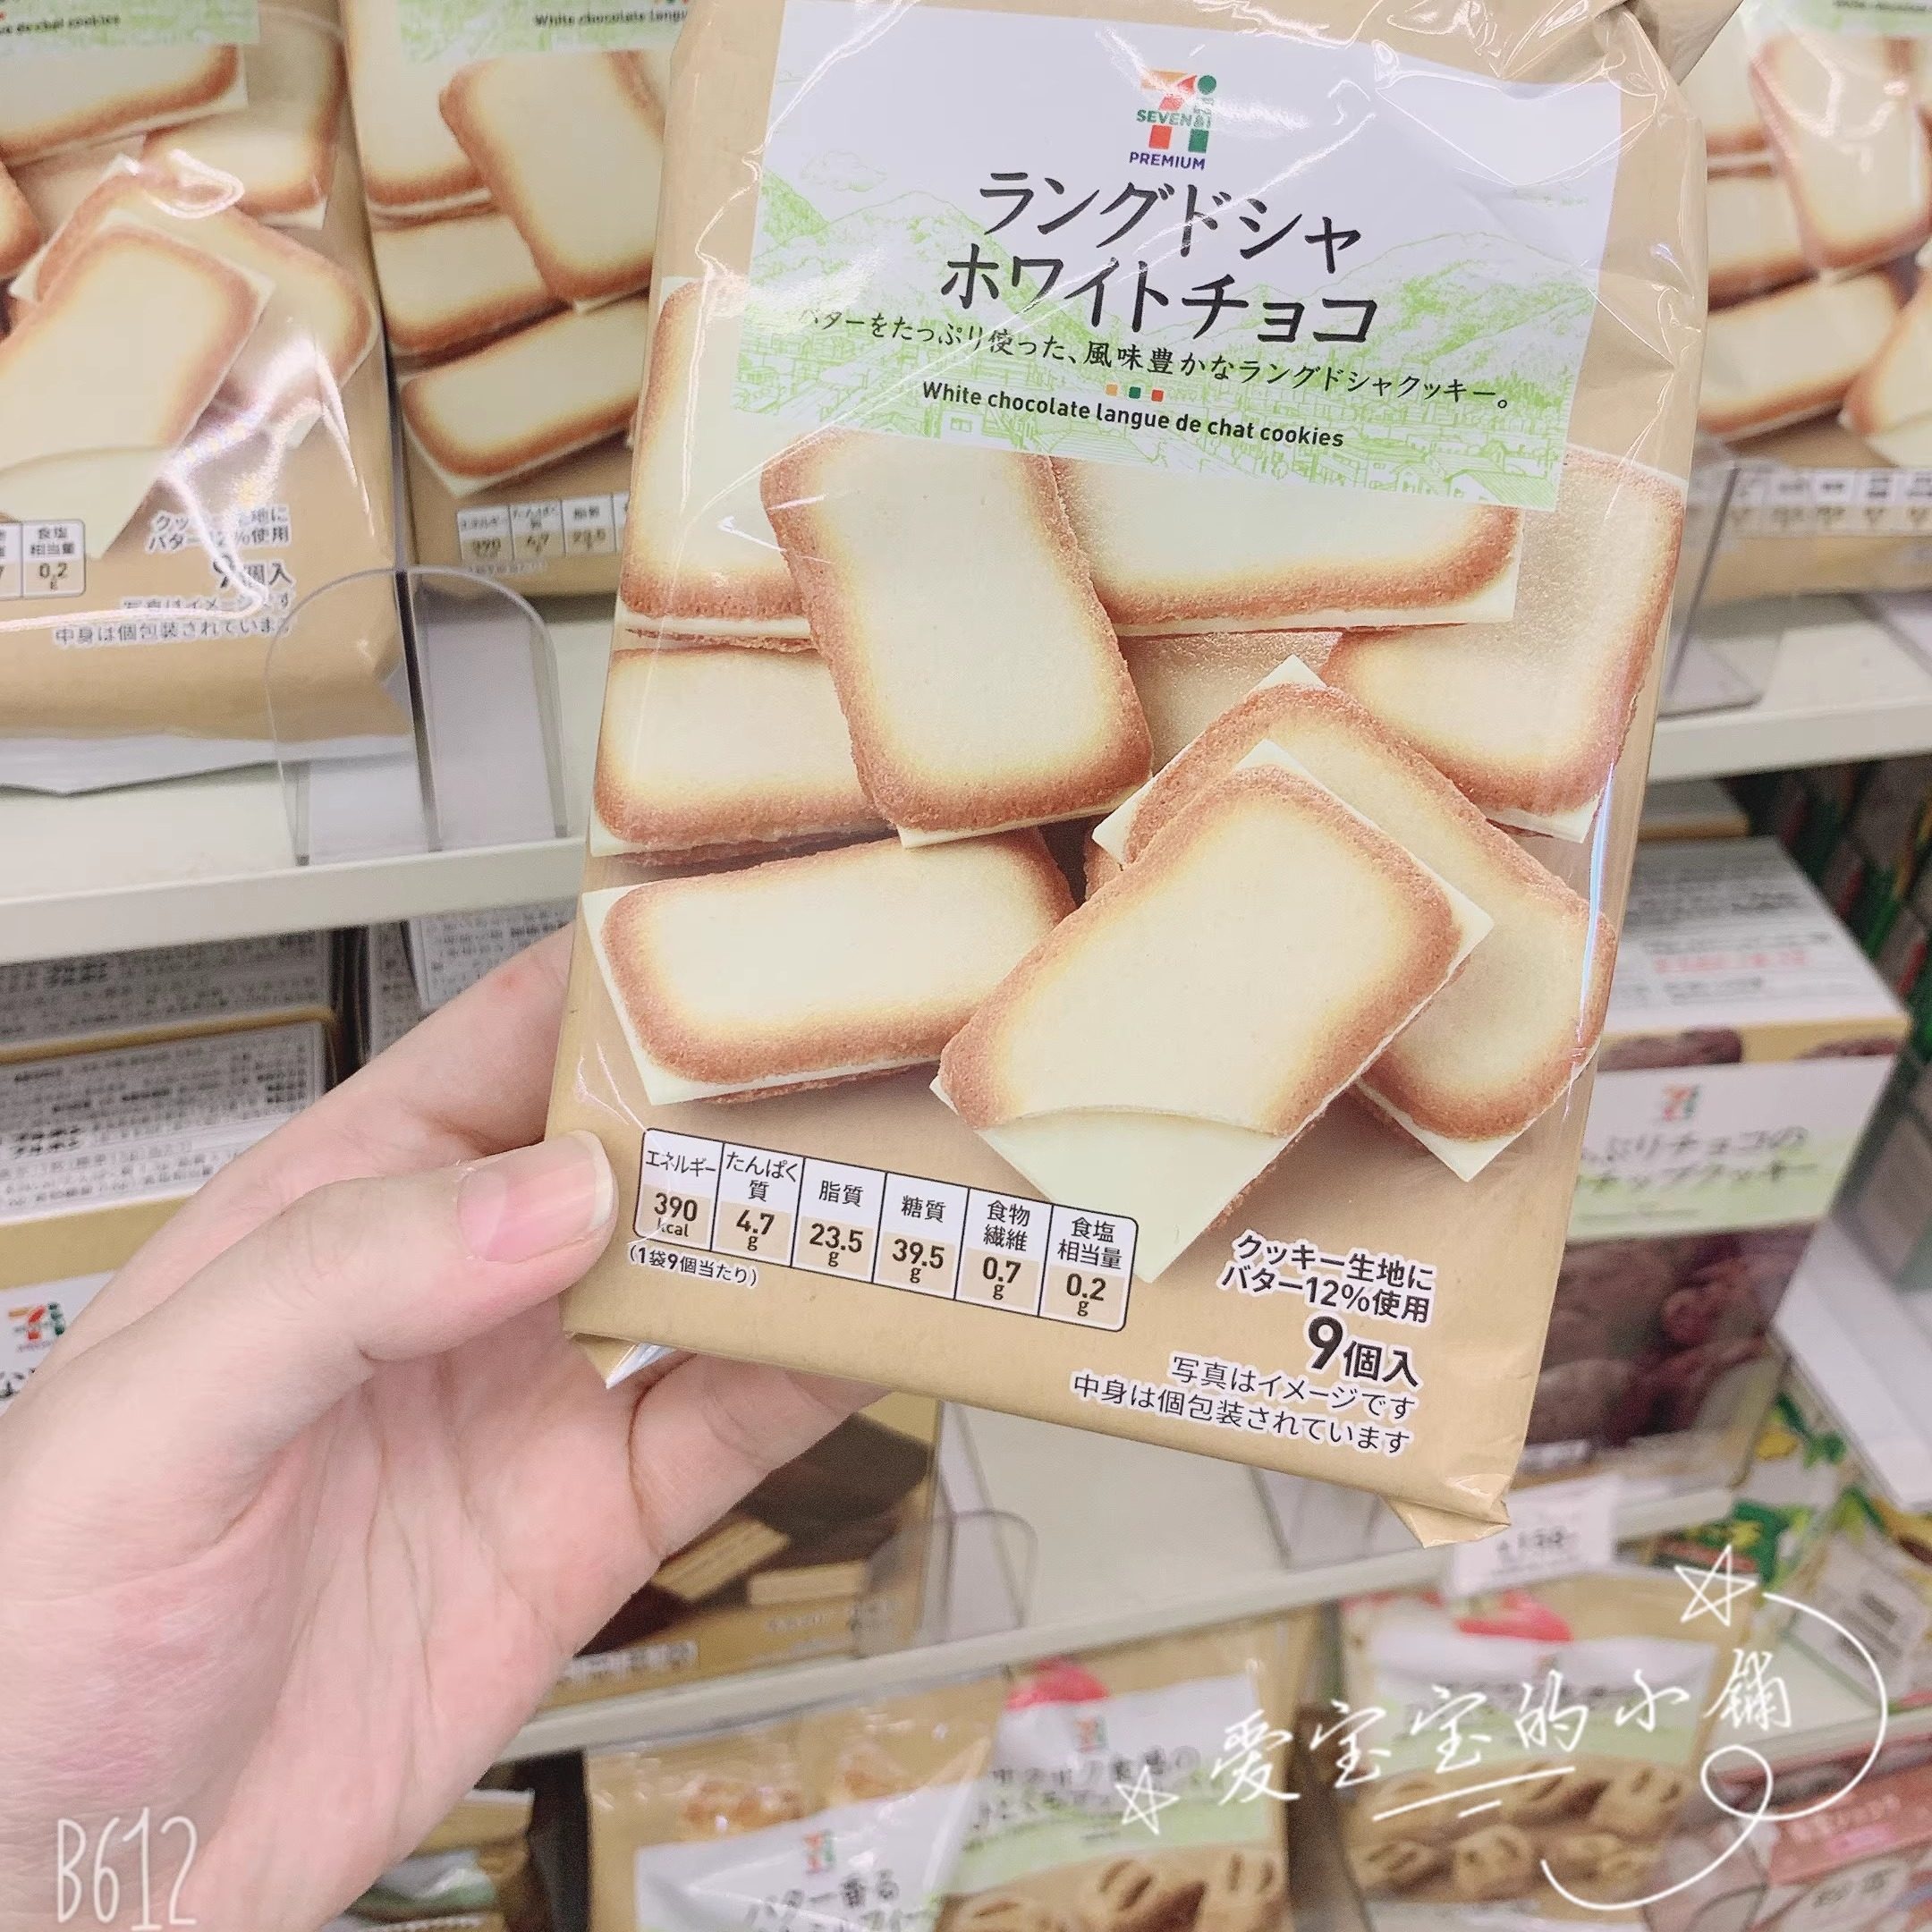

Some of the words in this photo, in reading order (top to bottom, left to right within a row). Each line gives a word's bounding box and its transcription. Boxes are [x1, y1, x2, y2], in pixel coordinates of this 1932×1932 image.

[1130, 151, 1206, 171] PREMIUM
[979, 171, 1362, 275] ラングドシャ
[940, 242, 1378, 343] ホワイトチョコ
[922, 380, 982, 406] White
[987, 389, 1090, 420] chocolate
[1096, 403, 1170, 431] langue
[1175, 412, 1201, 433] de
[1208, 418, 1254, 440] chat
[1259, 424, 1344, 448] cookies
[646, 1149, 716, 1178] エネルギー
[726, 1151, 798, 1183] たんぱく
[748, 1180, 770, 1203] 質
[818, 1179, 864, 1208] 脂質
[653, 1191, 699, 1223] 390
[901, 1194, 946, 1224] 糖質
[987, 1199, 1031, 1227] 食物
[657, 1217, 690, 1238] kcal
[736, 1209, 775, 1236] 4.7
[1071, 1216, 1116, 1244] 食塩
[747, 1234, 758, 1252] g
[809, 1223, 864, 1254] 23.5
[983, 1224, 1028, 1252] 繊維
[827, 1251, 840, 1267] g
[892, 1237, 945, 1269] 39.5
[1056, 1238, 1123, 1271] 相当量
[1236, 1233, 1434, 1292] クッキー生地に
[909, 1267, 922, 1284] g
[982, 1256, 1022, 1284] 0.7
[992, 1284, 1004, 1301] g
[1065, 1272, 1106, 1301] 0.2
[1221, 1265, 1431, 1325] バター12%使用
[1077, 1299, 1089, 1318] g
[1308, 1315, 1419, 1388] 9個入
[1172, 1355, 1416, 1421] 写真はイメージです
[1073, 1373, 1411, 1454] 中身は個包装されています
